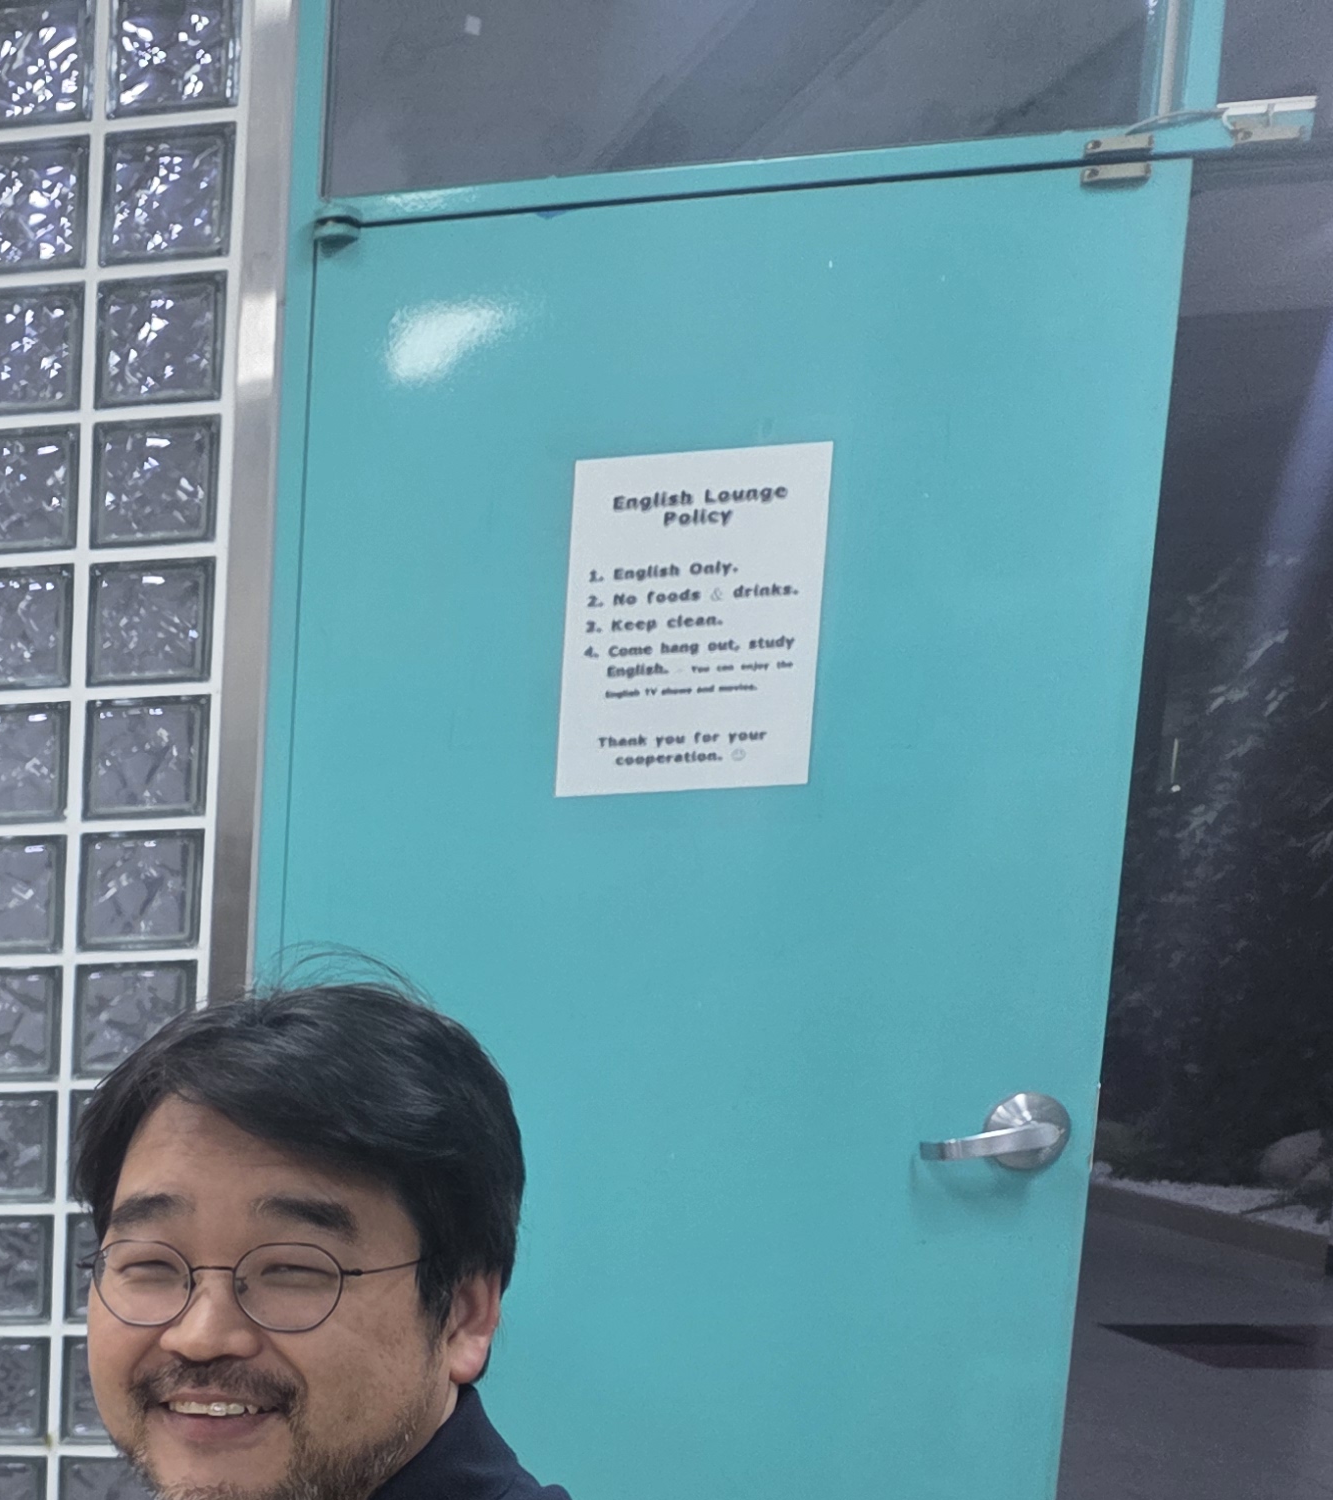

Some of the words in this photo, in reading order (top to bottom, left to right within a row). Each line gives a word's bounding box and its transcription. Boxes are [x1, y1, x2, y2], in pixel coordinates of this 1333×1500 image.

[613, 490, 693, 512] English
[704, 485, 788, 504] Lounge
[663, 509, 733, 527] Policy
[589, 569, 604, 583] 1.
[613, 564, 680, 581] English
[689, 560, 739, 577] Only.
[587, 594, 604, 608] 2.
[613, 592, 637, 606] No
[647, 588, 701, 603] foods
[733, 583, 799, 599] drinks.
[585, 620, 602, 634] 3.
[611, 618, 658, 632] Keep
[666, 614, 724, 629] clean.
[583, 646, 600, 659] 4.
[608, 645, 653, 657] Come
[659, 642, 699, 655] hang
[707, 639, 740, 653] out,
[748, 635, 795, 651] study
[606, 662, 669, 679] English.
[740, 662, 770, 672] enjoy
[776, 660, 794, 669] the
[605, 689, 640, 699] English
[645, 688, 657, 696] TV
[696, 685, 715, 693] and
[598, 734, 647, 748] Thank
[655, 733, 686, 748] you
[694, 731, 720, 744] for
[728, 729, 768, 744] your
[615, 750, 723, 768] cooperation.
